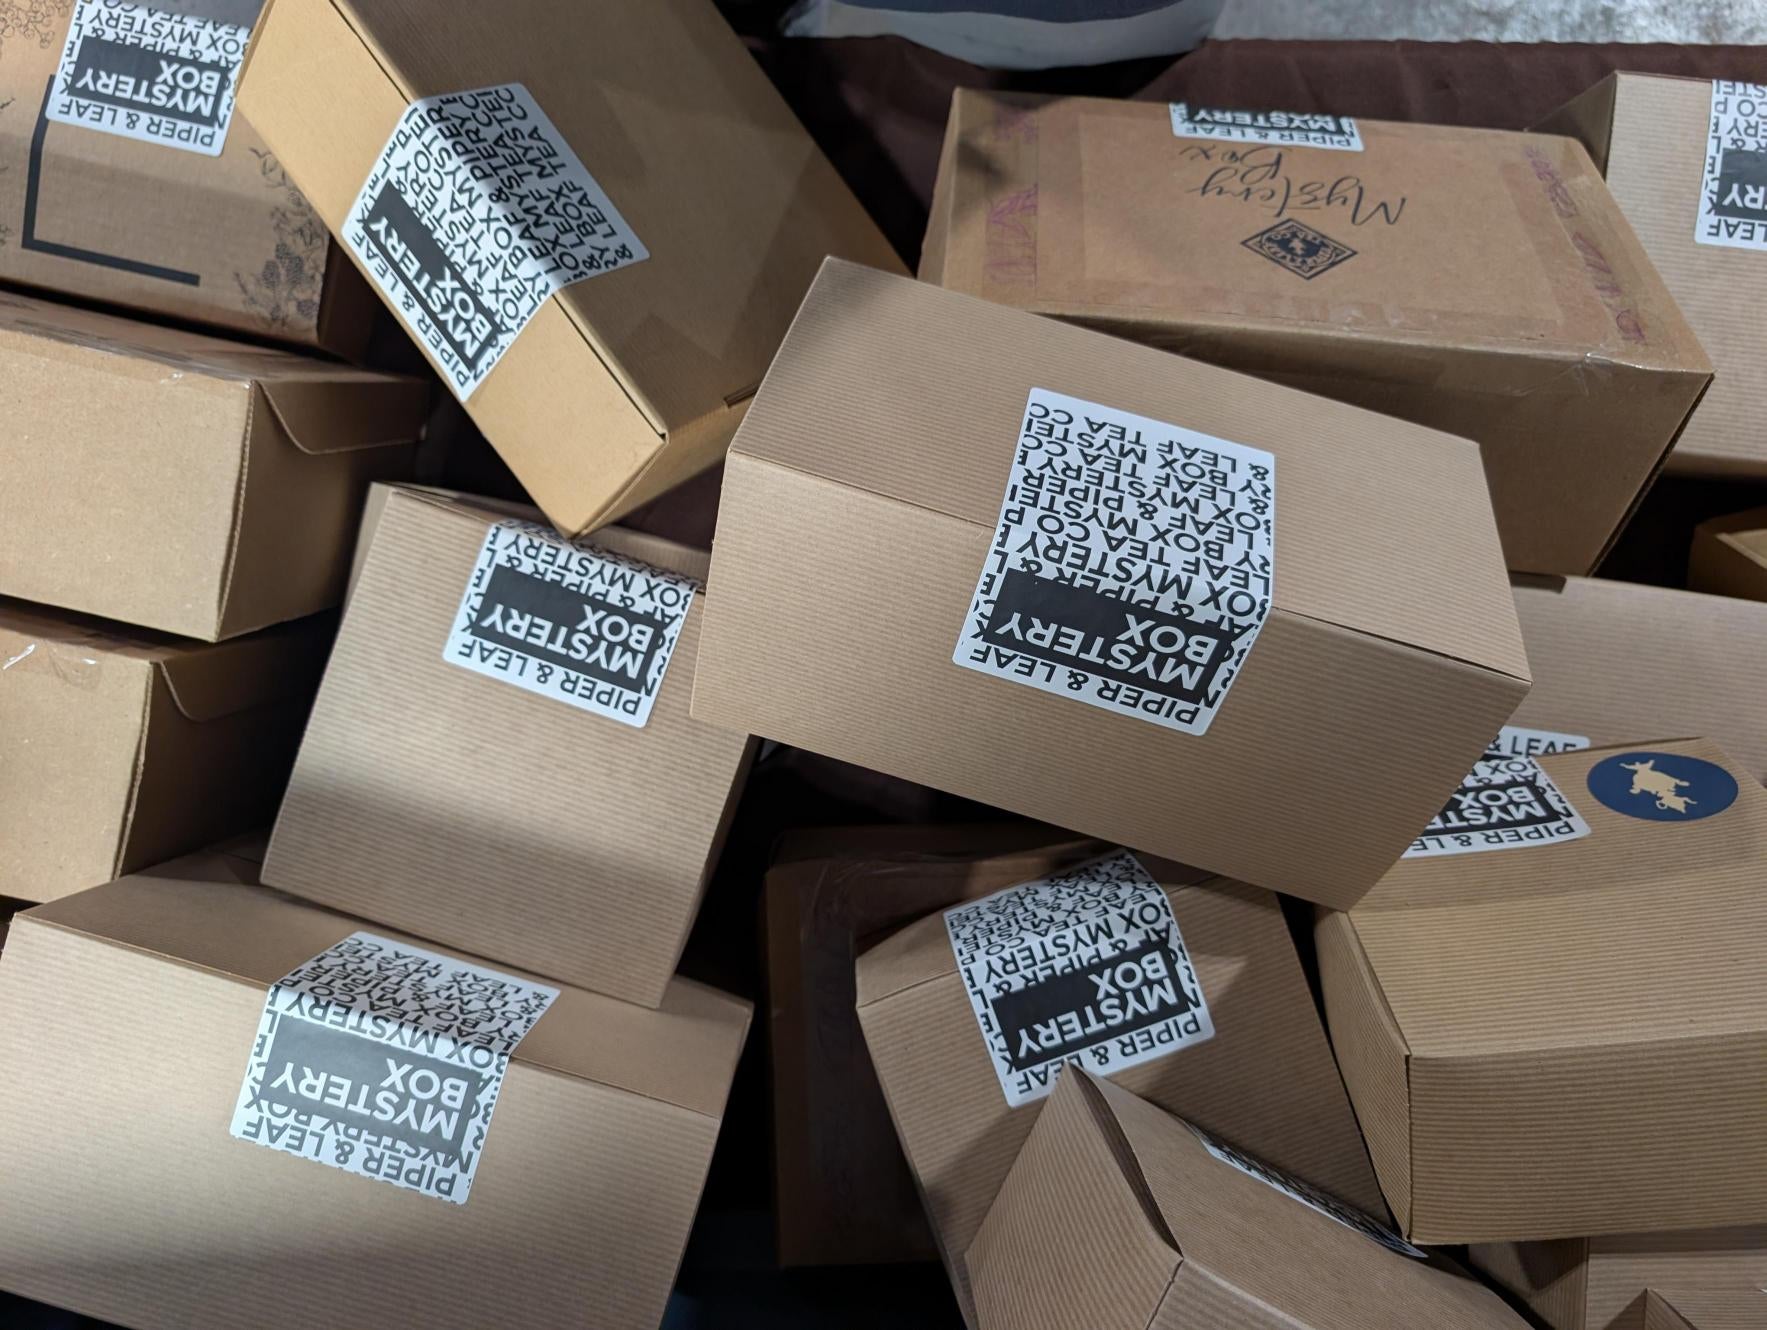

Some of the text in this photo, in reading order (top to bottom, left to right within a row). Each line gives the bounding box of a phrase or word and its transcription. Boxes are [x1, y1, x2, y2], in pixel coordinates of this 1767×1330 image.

[89, 10, 200, 45] MYSTERY
[92, 26, 105, 38] &
[75, 68, 214, 117] MYSTERY
[156, 60, 220, 93] BOX
[59, 99, 215, 147] PIPER & LEAF
[1185, 125, 1351, 147] PIPER & LEAF
[1194, 110, 1335, 131] MYSTERY
[414, 151, 445, 189] CO
[451, 108, 548, 232] MYSTERY
[493, 133, 532, 181] TEA
[526, 126, 566, 173] TEA
[1179, 144, 1294, 185] Box
[425, 105, 561, 273] LEAF & PIPER
[562, 180, 618, 237] LEAF
[1187, 167, 1406, 226] Mystery
[396, 161, 487, 278] MYSTERY
[449, 190, 486, 248] TEA
[528, 191, 585, 249] LEAF
[550, 185, 597, 237] BOX
[478, 207, 527, 266] BOX
[616, 243, 634, 260] &
[367, 214, 479, 358] MYSTERY
[434, 265, 493, 335] BOX
[485, 250, 537, 316] LEAF
[352, 231, 470, 388] PIPER & LEAF
[1083, 417, 1147, 446] TEA
[1078, 450, 1142, 479] TEA
[1157, 440, 1237, 472] LEAF
[1157, 454, 1227, 488] BOX
[1248, 465, 1268, 480] &
[1036, 457, 1200, 513] MYSTERY
[1153, 473, 1235, 504] LEAF
[1248, 498, 1269, 515] &
[1022, 469, 1253, 548] LEAF & PIPER
[1037, 514, 1090, 545] CO
[503, 533, 636, 593] MYSTERY
[505, 554, 522, 570] &
[1102, 530, 1170, 567] TEA
[1147, 524, 1225, 559] BOX
[1016, 531, 1192, 596] MYSTERY
[1020, 558, 1042, 576] &
[1182, 557, 1269, 595] LEAF
[479, 603, 645, 678] MYSTERY
[576, 604, 654, 650] BOX
[1115, 613, 1218, 664] BOX
[995, 612, 1205, 691] MYSTERY
[458, 640, 641, 715] PIPER & LEAF
[969, 646, 1201, 725] PIPER & LEAF
[1452, 786, 1534, 809] BOX
[1452, 835, 1472, 846] &
[1480, 821, 1575, 844] PIPER
[1062, 892, 1119, 917] BOX
[985, 937, 1024, 954] CO
[1030, 916, 1087, 937] TEA
[984, 919, 1112, 982] MYSTERY
[310, 986, 356, 1004] CO
[329, 962, 472, 1006] MYSTERY
[377, 964, 425, 983] TEA
[393, 951, 549, 1001] & LEAF TEA
[445, 977, 509, 998] BOX
[992, 981, 1012, 995] &
[1088, 950, 1169, 999] BOX
[310, 964, 512, 1028] LEAF & PIPER
[370, 1000, 424, 1025] TEA
[414, 1004, 479, 1029] BOX
[436, 984, 508, 1008] LEAF
[1018, 977, 1179, 1058] MYSTERY
[286, 992, 438, 1053] MYSTERY
[432, 1023, 513, 1051] LEAF
[1116, 1013, 1200, 1058] PIPER
[1090, 1046, 1109, 1066] &
[269, 1061, 460, 1140] MYSTERY
[379, 1057, 468, 1109] BOX
[242, 1114, 324, 1156] LEAF
[335, 1140, 355, 1163] &
[363, 1148, 457, 1197] PIPER
